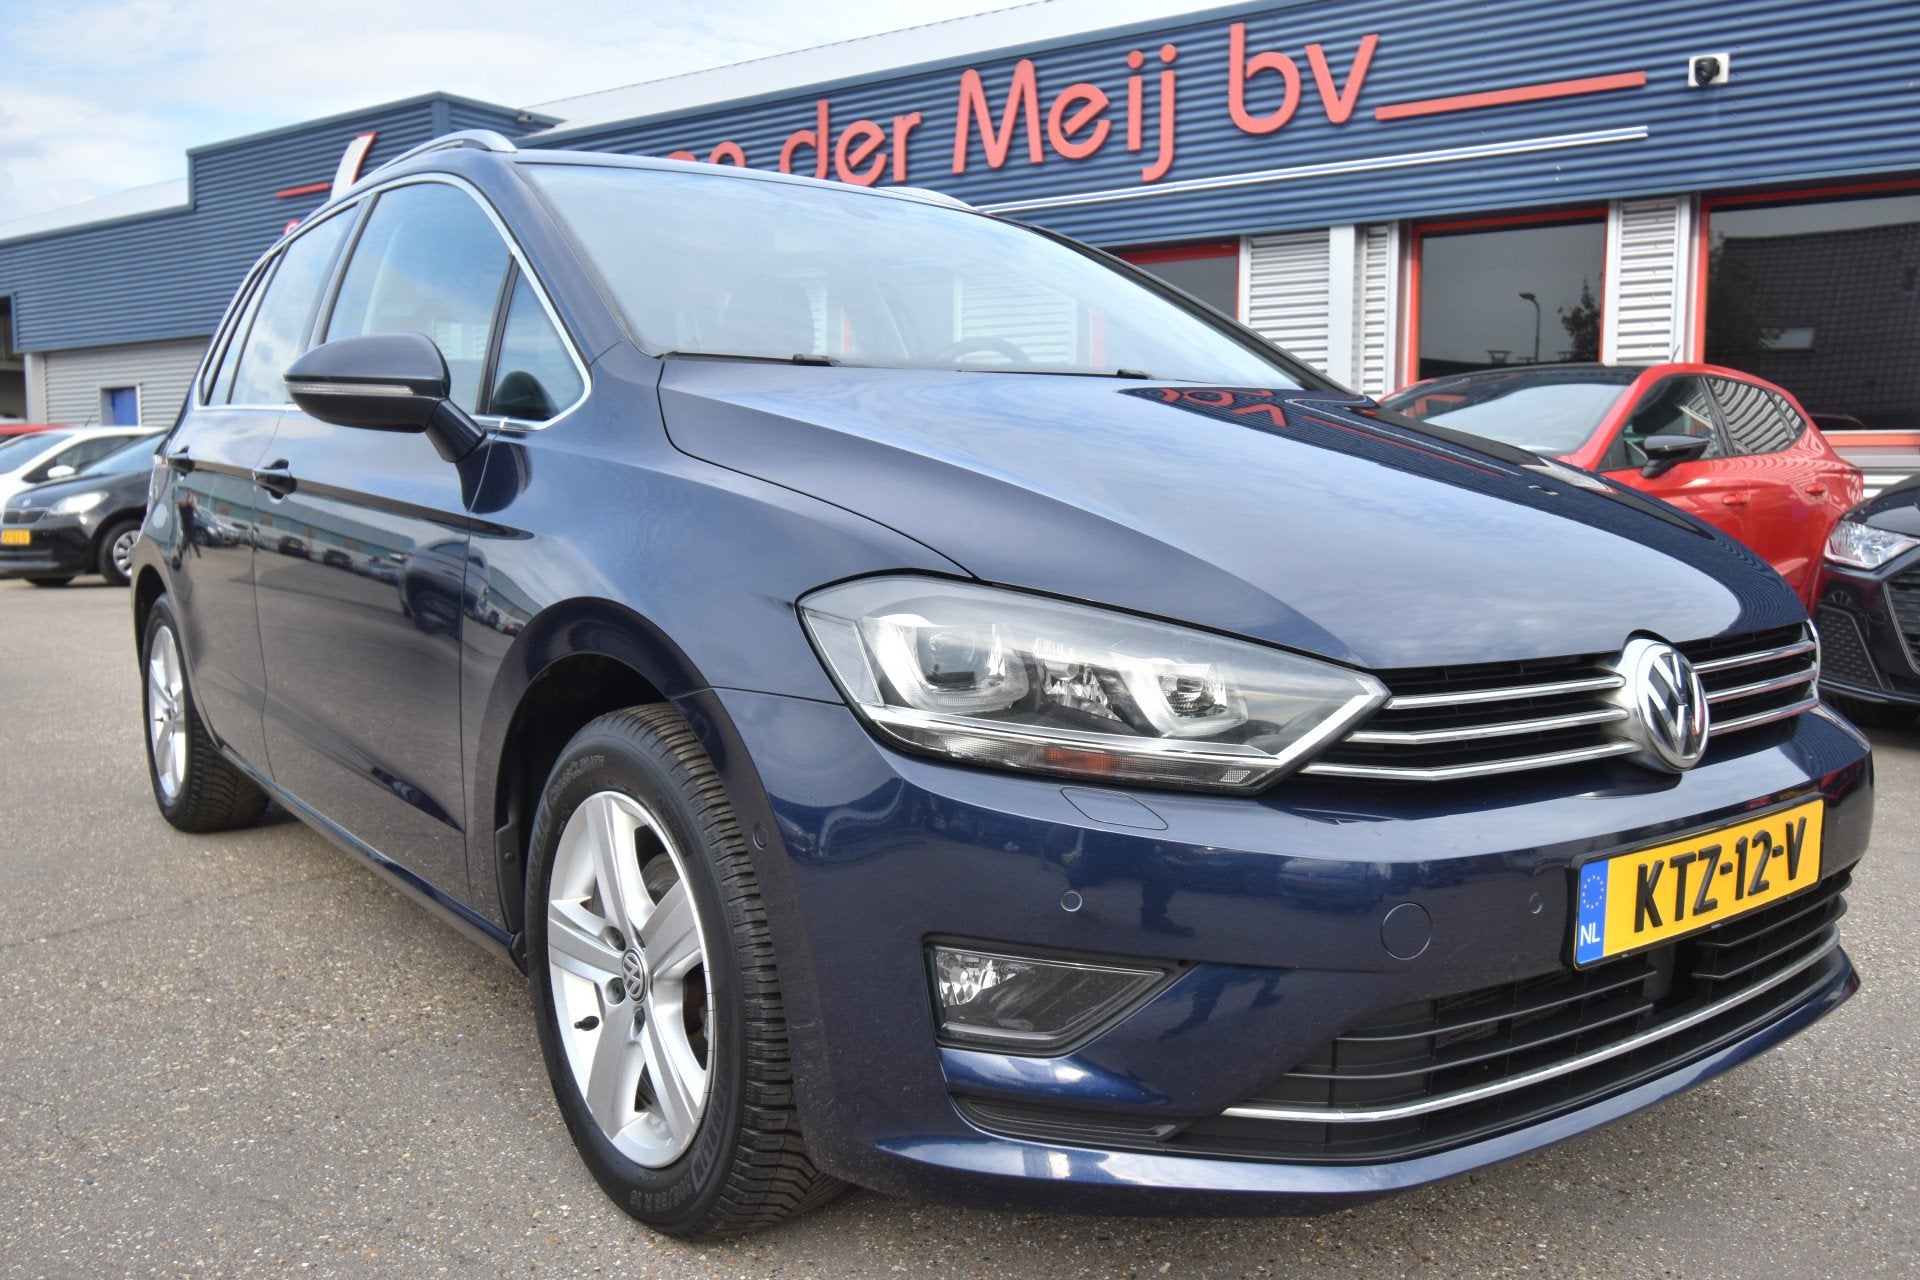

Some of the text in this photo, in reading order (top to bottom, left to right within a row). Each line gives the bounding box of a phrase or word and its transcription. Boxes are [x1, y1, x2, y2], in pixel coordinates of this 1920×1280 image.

[778, 22, 1380, 188] der Meij bv
[1633, 816, 1808, 933] KTZ-12-V
[1579, 922, 1601, 947] NL
